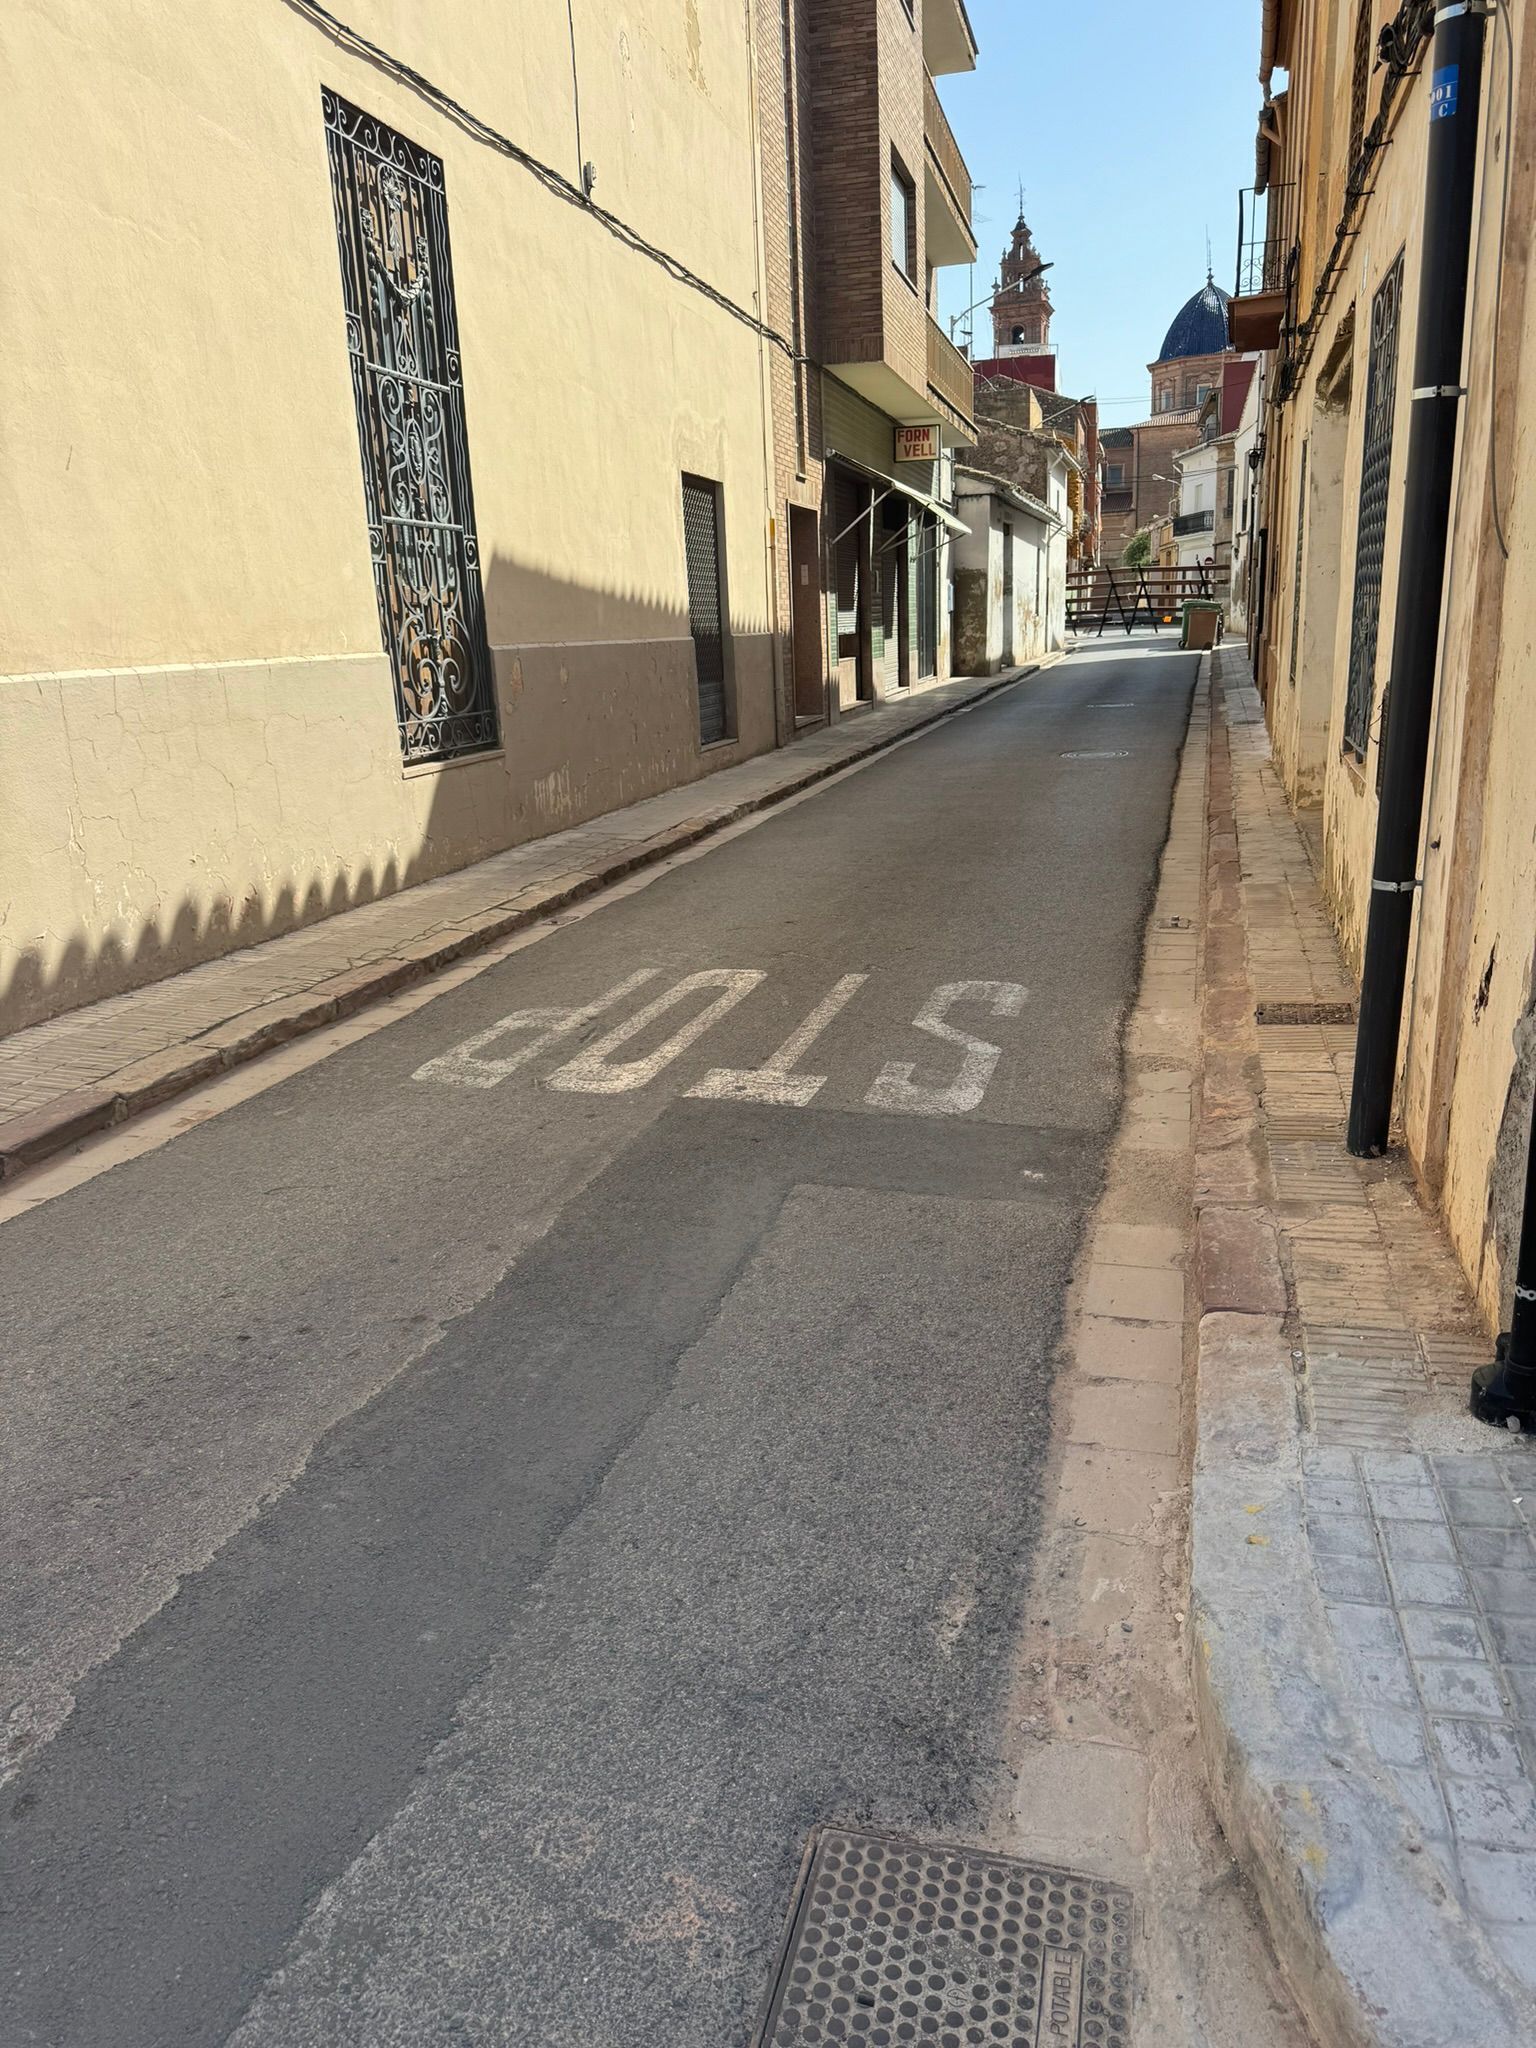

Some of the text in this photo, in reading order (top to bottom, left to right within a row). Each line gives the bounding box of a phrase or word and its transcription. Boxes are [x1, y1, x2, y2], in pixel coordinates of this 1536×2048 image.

[897, 428, 930, 443] FORN
[903, 443, 936, 457] VELL
[411, 968, 1029, 1115] STOP
[1050, 1951, 1073, 2038] POTABLE
